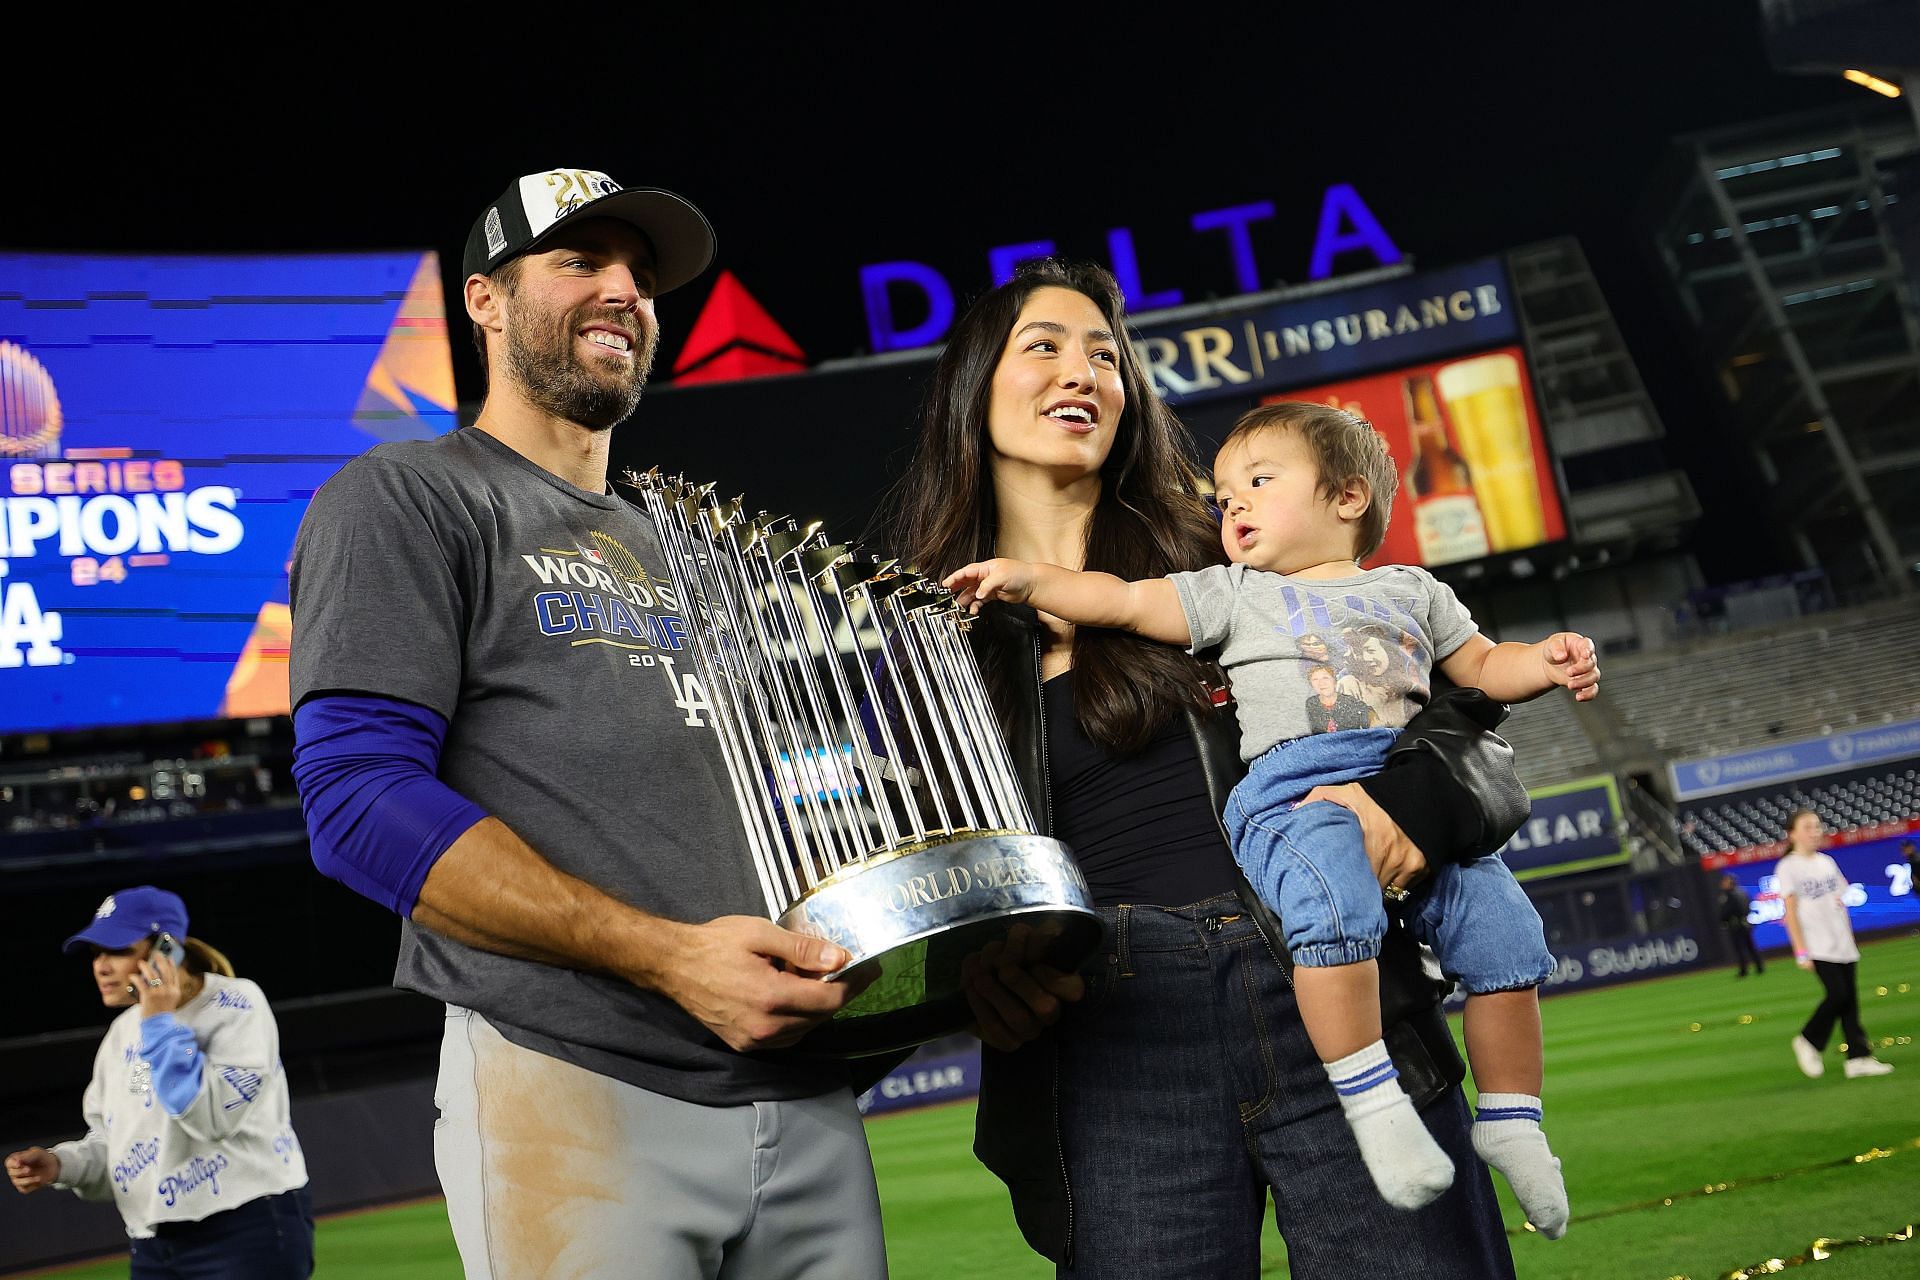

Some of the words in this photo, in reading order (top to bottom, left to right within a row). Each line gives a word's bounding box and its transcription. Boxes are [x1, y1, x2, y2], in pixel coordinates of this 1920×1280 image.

[1264, 284, 1502, 363] INSURANCE
[10, 460, 185, 495] SERIES
[521, 555, 653, 608] WORLD
[628, 654, 656, 667] 20
[1500, 809, 1603, 853] LEAR
[884, 865, 972, 913] ORLD
[1588, 945, 1699, 977] StubHub
[158, 1153, 229, 1207] Phillips
